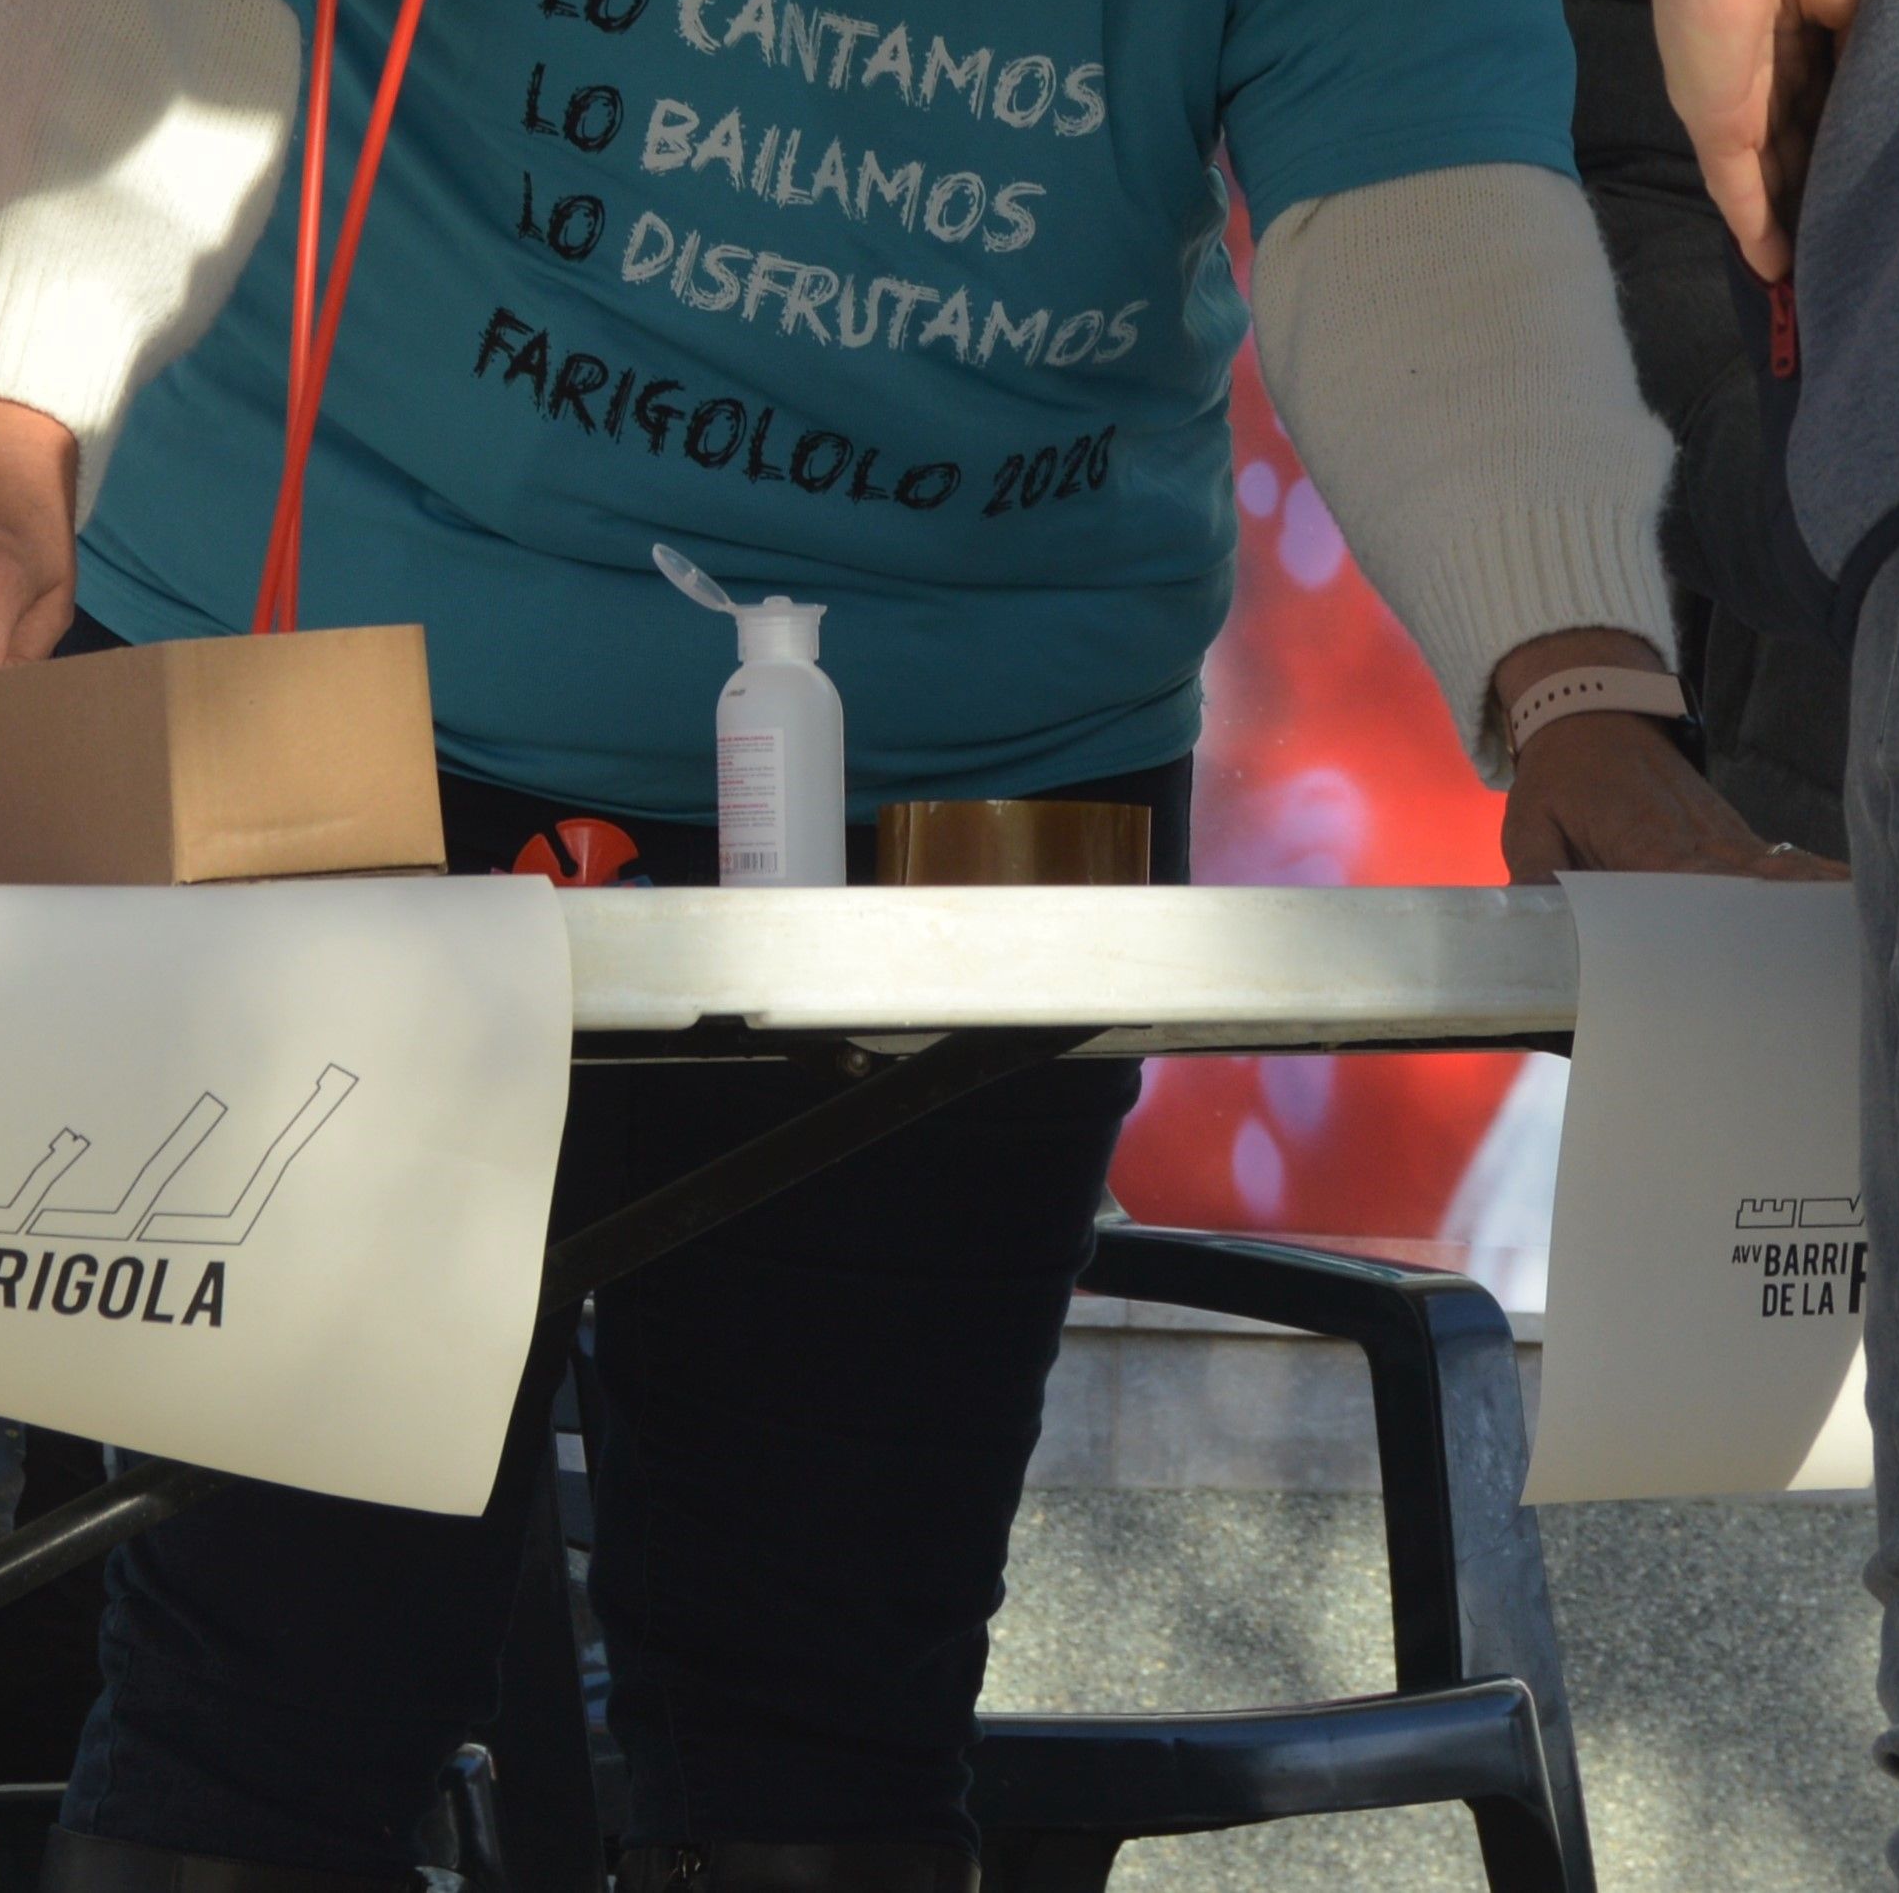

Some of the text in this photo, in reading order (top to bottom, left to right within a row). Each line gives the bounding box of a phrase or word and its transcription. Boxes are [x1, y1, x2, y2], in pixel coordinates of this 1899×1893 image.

[523, 63, 1046, 253] LO BAILAMOS
[516, 172, 1149, 368] LO DISFRUTAMOS
[473, 308, 1117, 518] FARIGOLOLO 2020
[1731, 1242, 1847, 1277] AVV BARRI
[1761, 1280, 1834, 1317] DE LA
